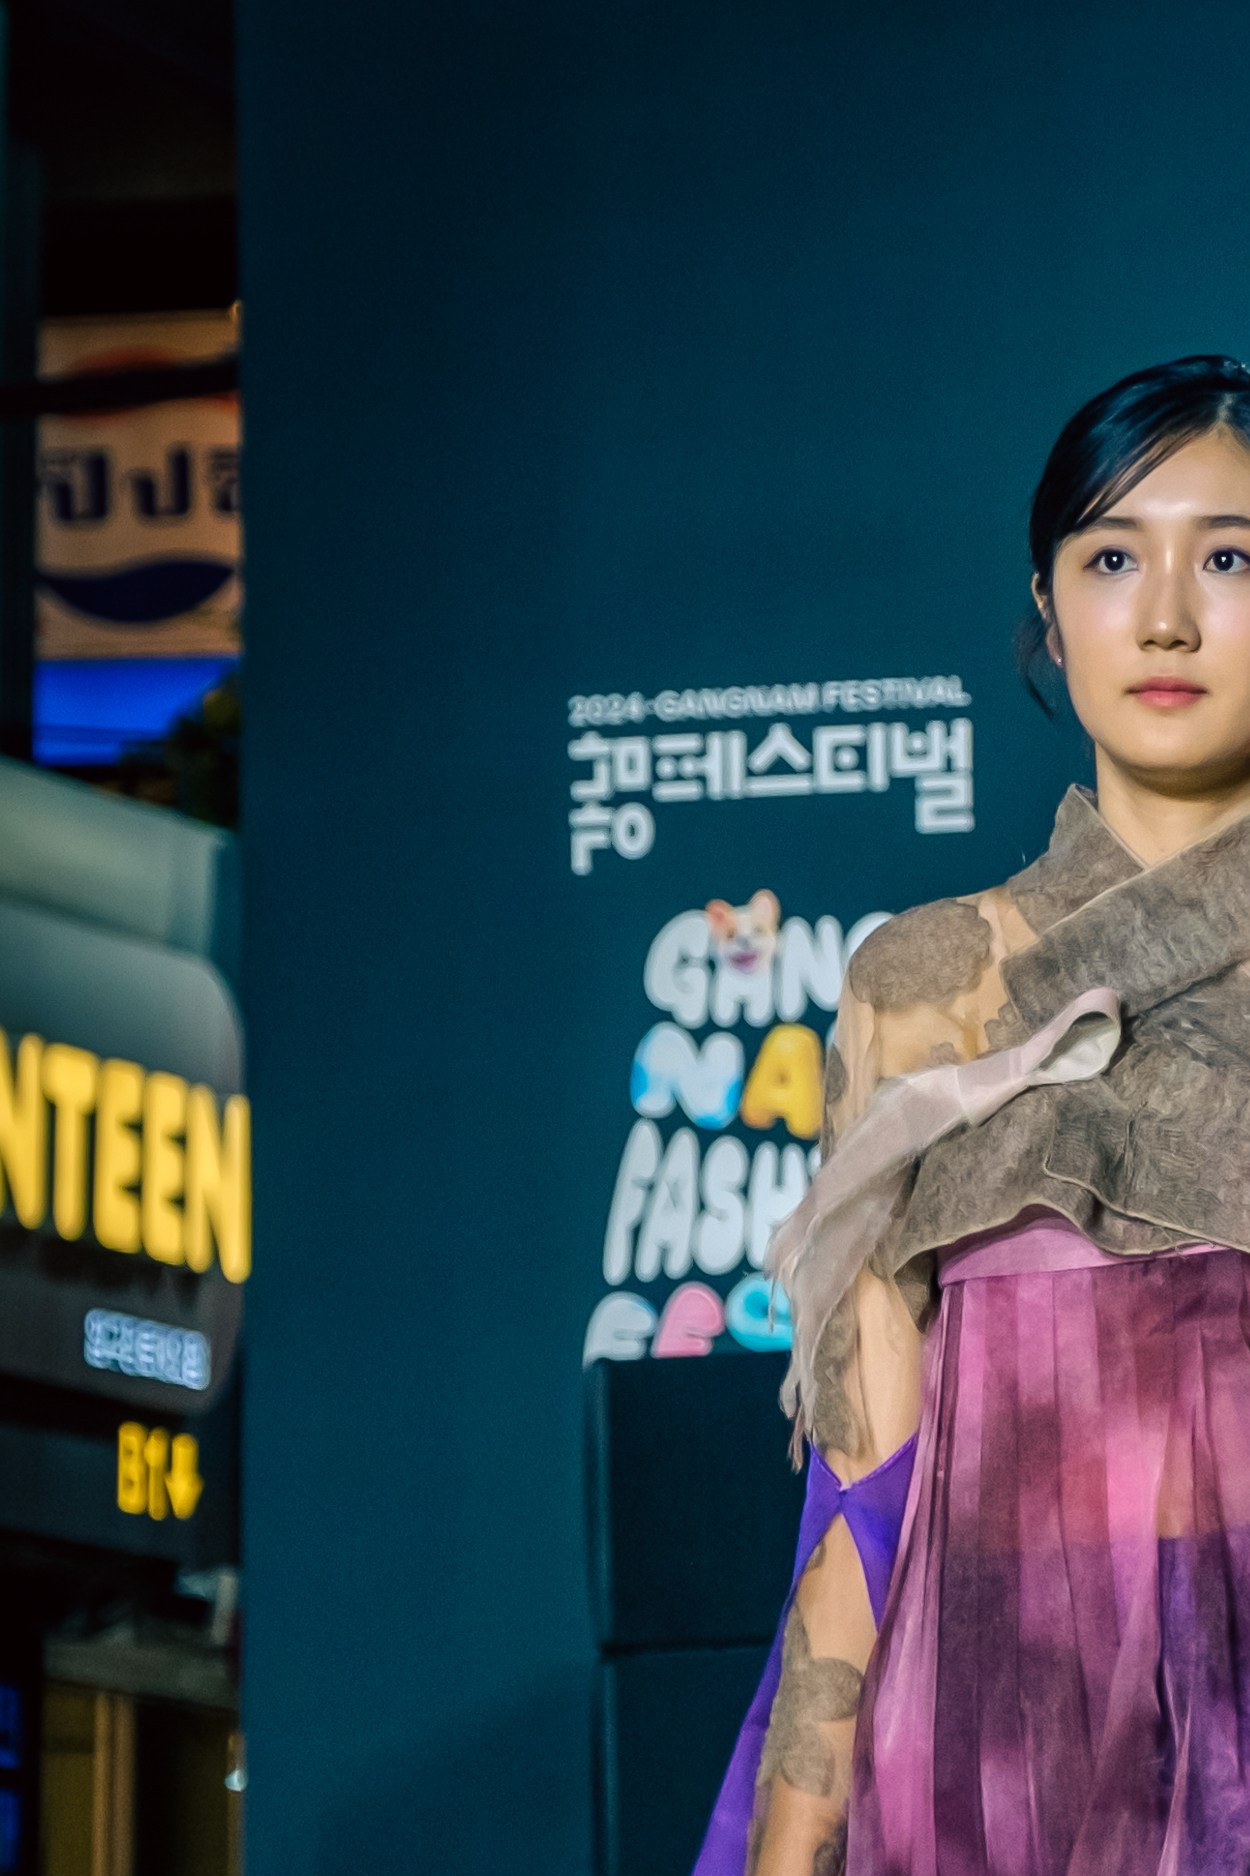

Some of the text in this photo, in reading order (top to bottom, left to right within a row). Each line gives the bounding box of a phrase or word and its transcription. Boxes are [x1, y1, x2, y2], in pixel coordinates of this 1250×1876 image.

[568, 675, 972, 727] 2024 GANGNAM FESTIVAL
[644, 909, 893, 1028] GAN
[630, 1021, 838, 1140] NA
[602, 1117, 822, 1286] FASH
